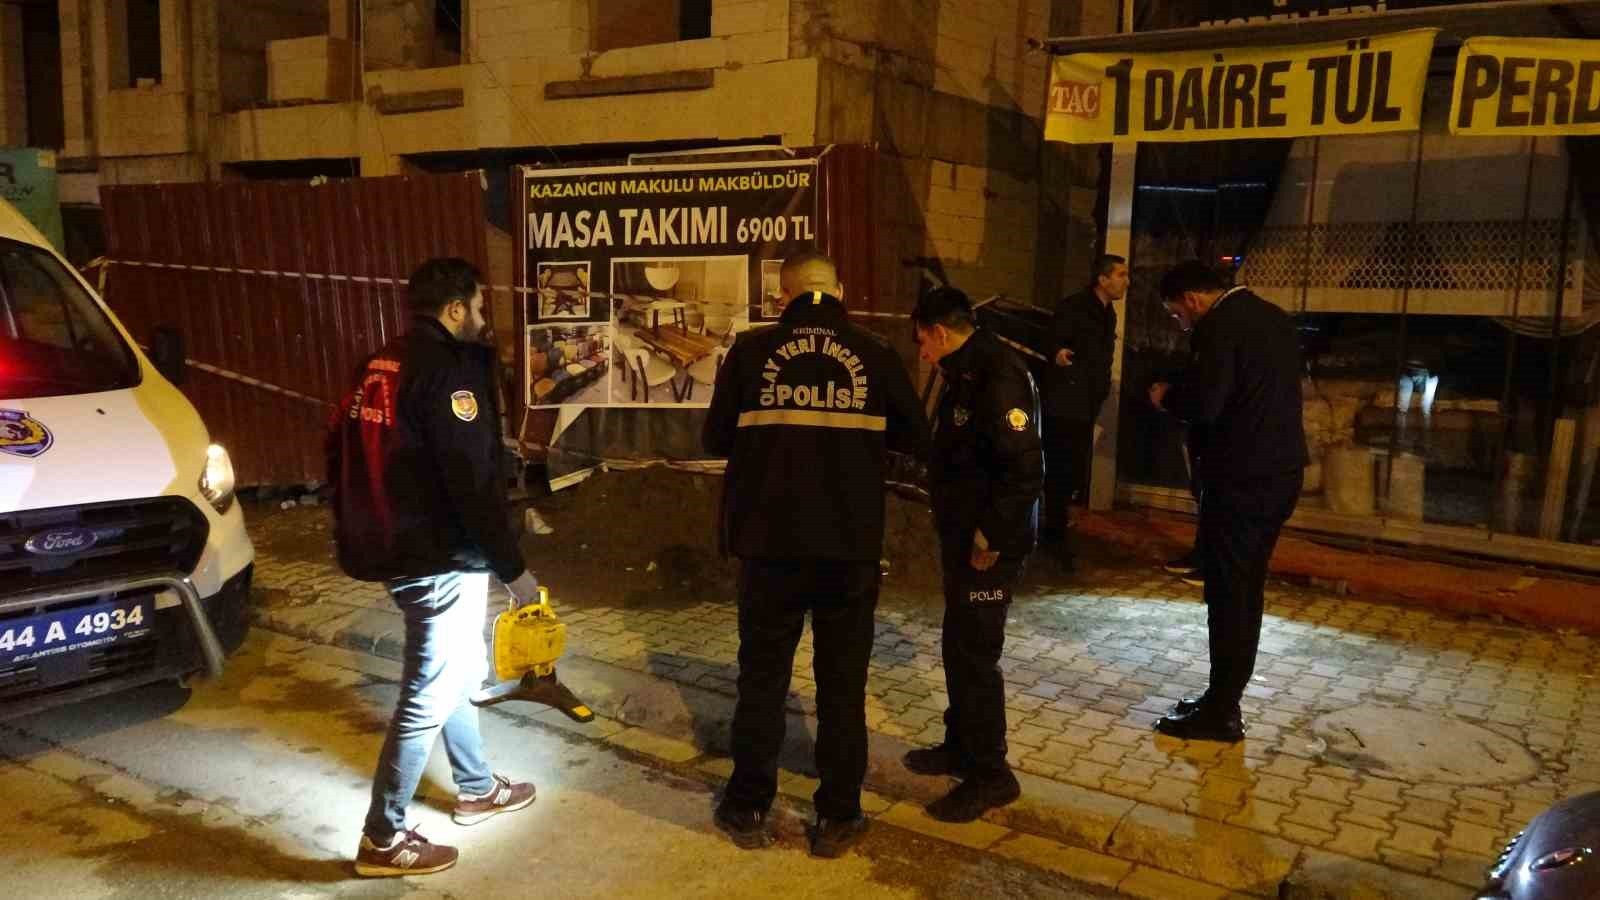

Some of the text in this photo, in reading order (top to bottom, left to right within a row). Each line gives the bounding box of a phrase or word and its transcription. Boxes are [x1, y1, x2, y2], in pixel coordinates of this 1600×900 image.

[1105, 38, 1402, 136] 1 DAİRE TÜL
[530, 169, 810, 198] KAZANCIN MAKULU MAKBÜLDÜR
[528, 206, 815, 249] MASA TAKIMI 6900 TL
[760, 357, 780, 406] OLAY
[44, 532, 82, 549] Ford
[0, 626, 35, 651] 44
[44, 620, 67, 644] A
[75, 605, 144, 635] 4934
